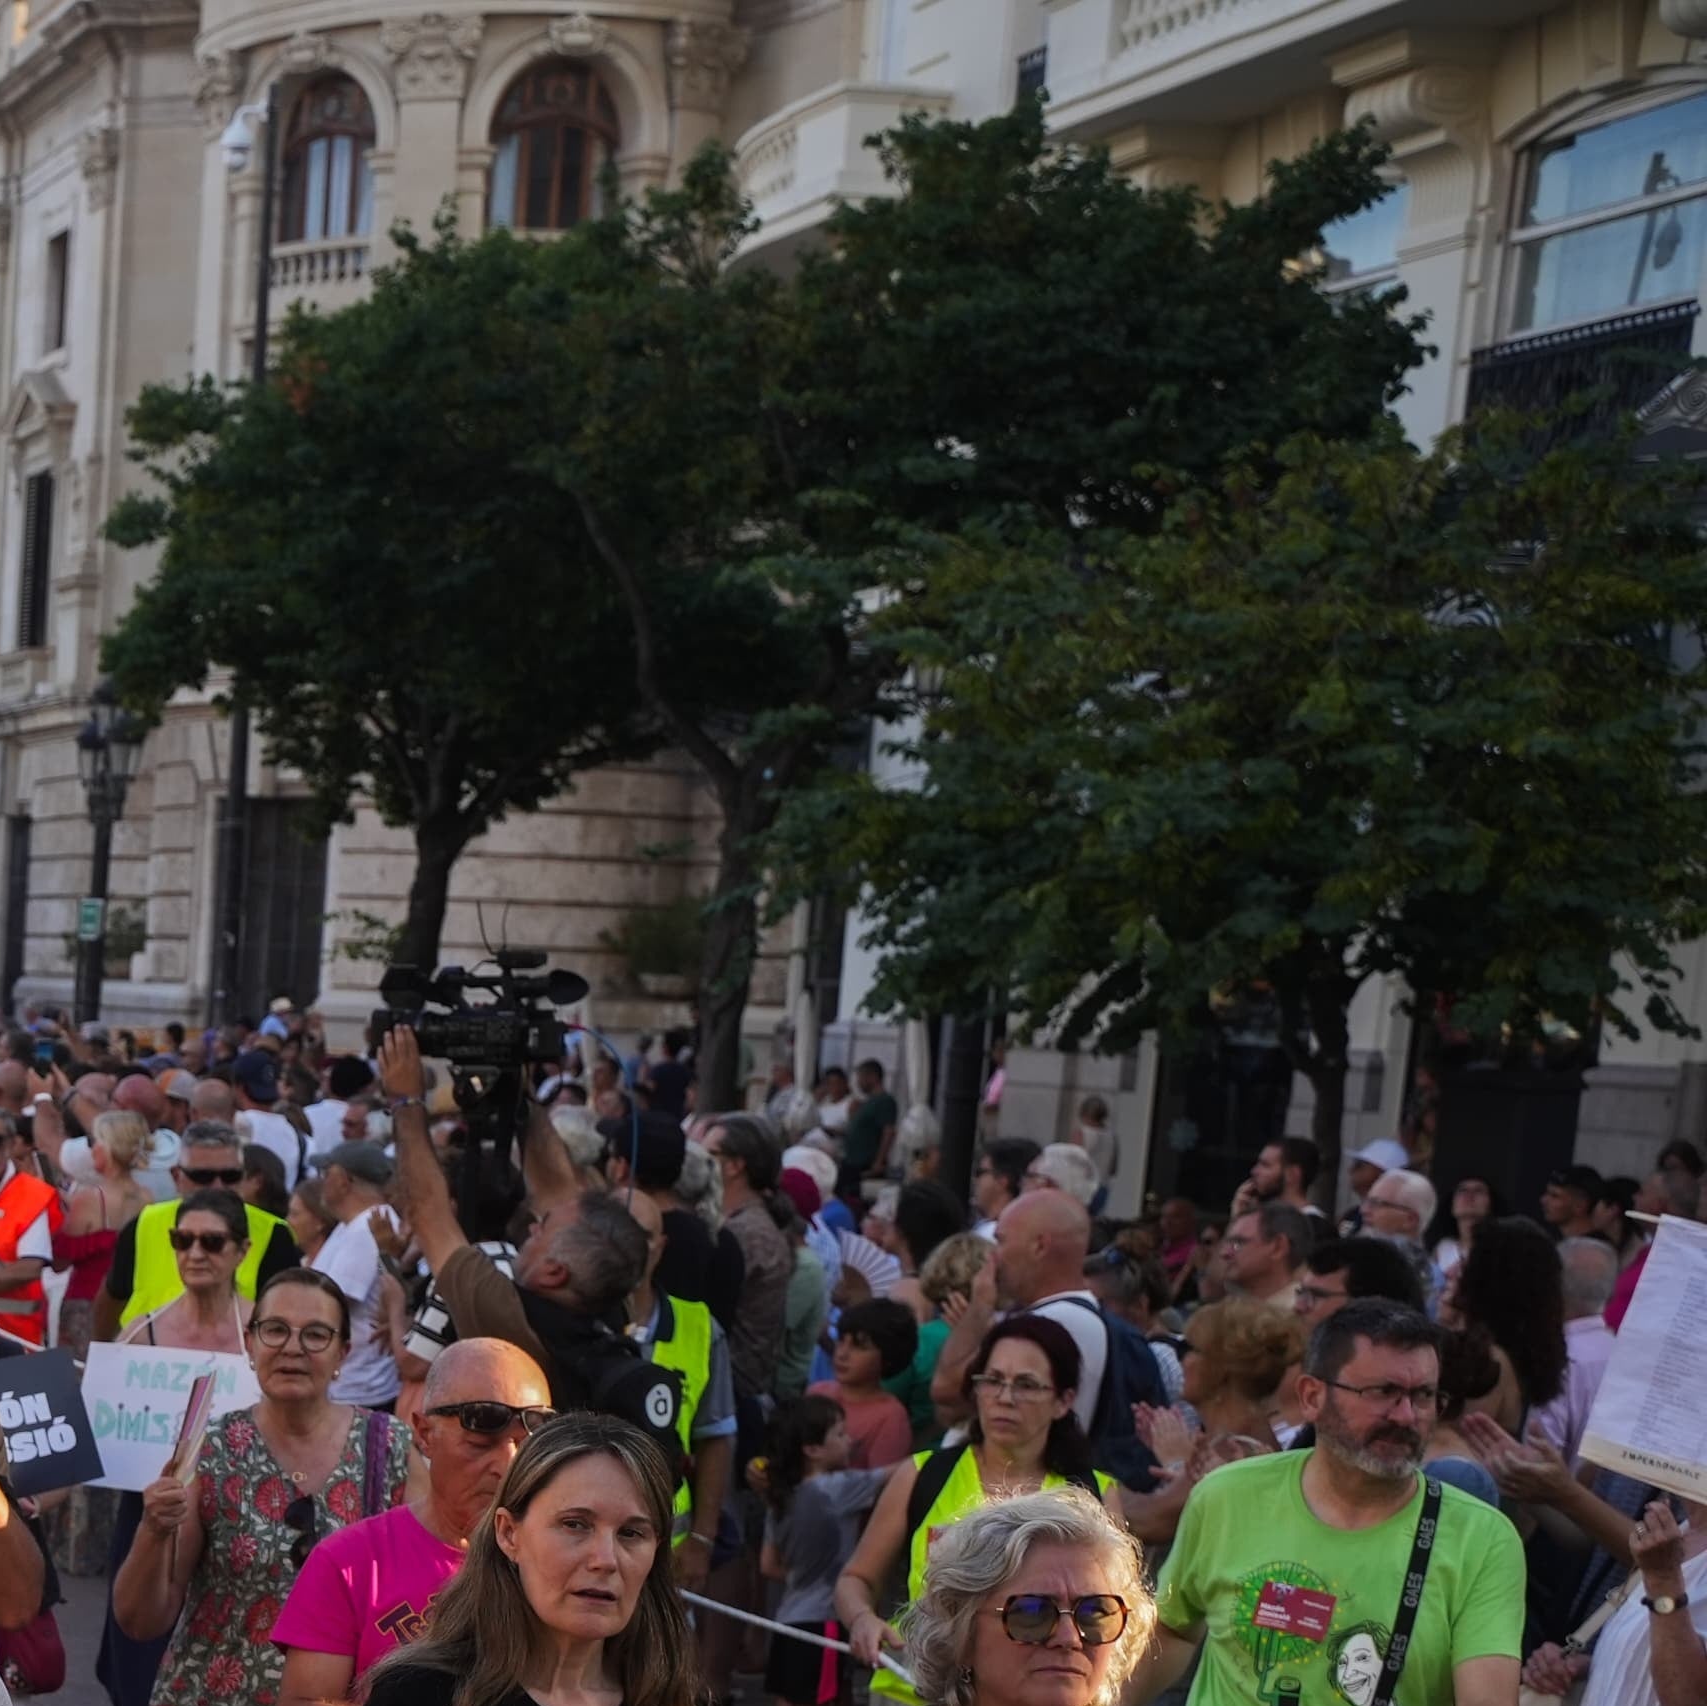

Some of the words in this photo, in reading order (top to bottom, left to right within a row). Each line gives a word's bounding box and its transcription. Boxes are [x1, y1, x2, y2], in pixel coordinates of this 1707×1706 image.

[1416, 1518, 1436, 1550] GAES
[1403, 1572, 1423, 1608] GAES
[1387, 1634, 1408, 1672] GAES
